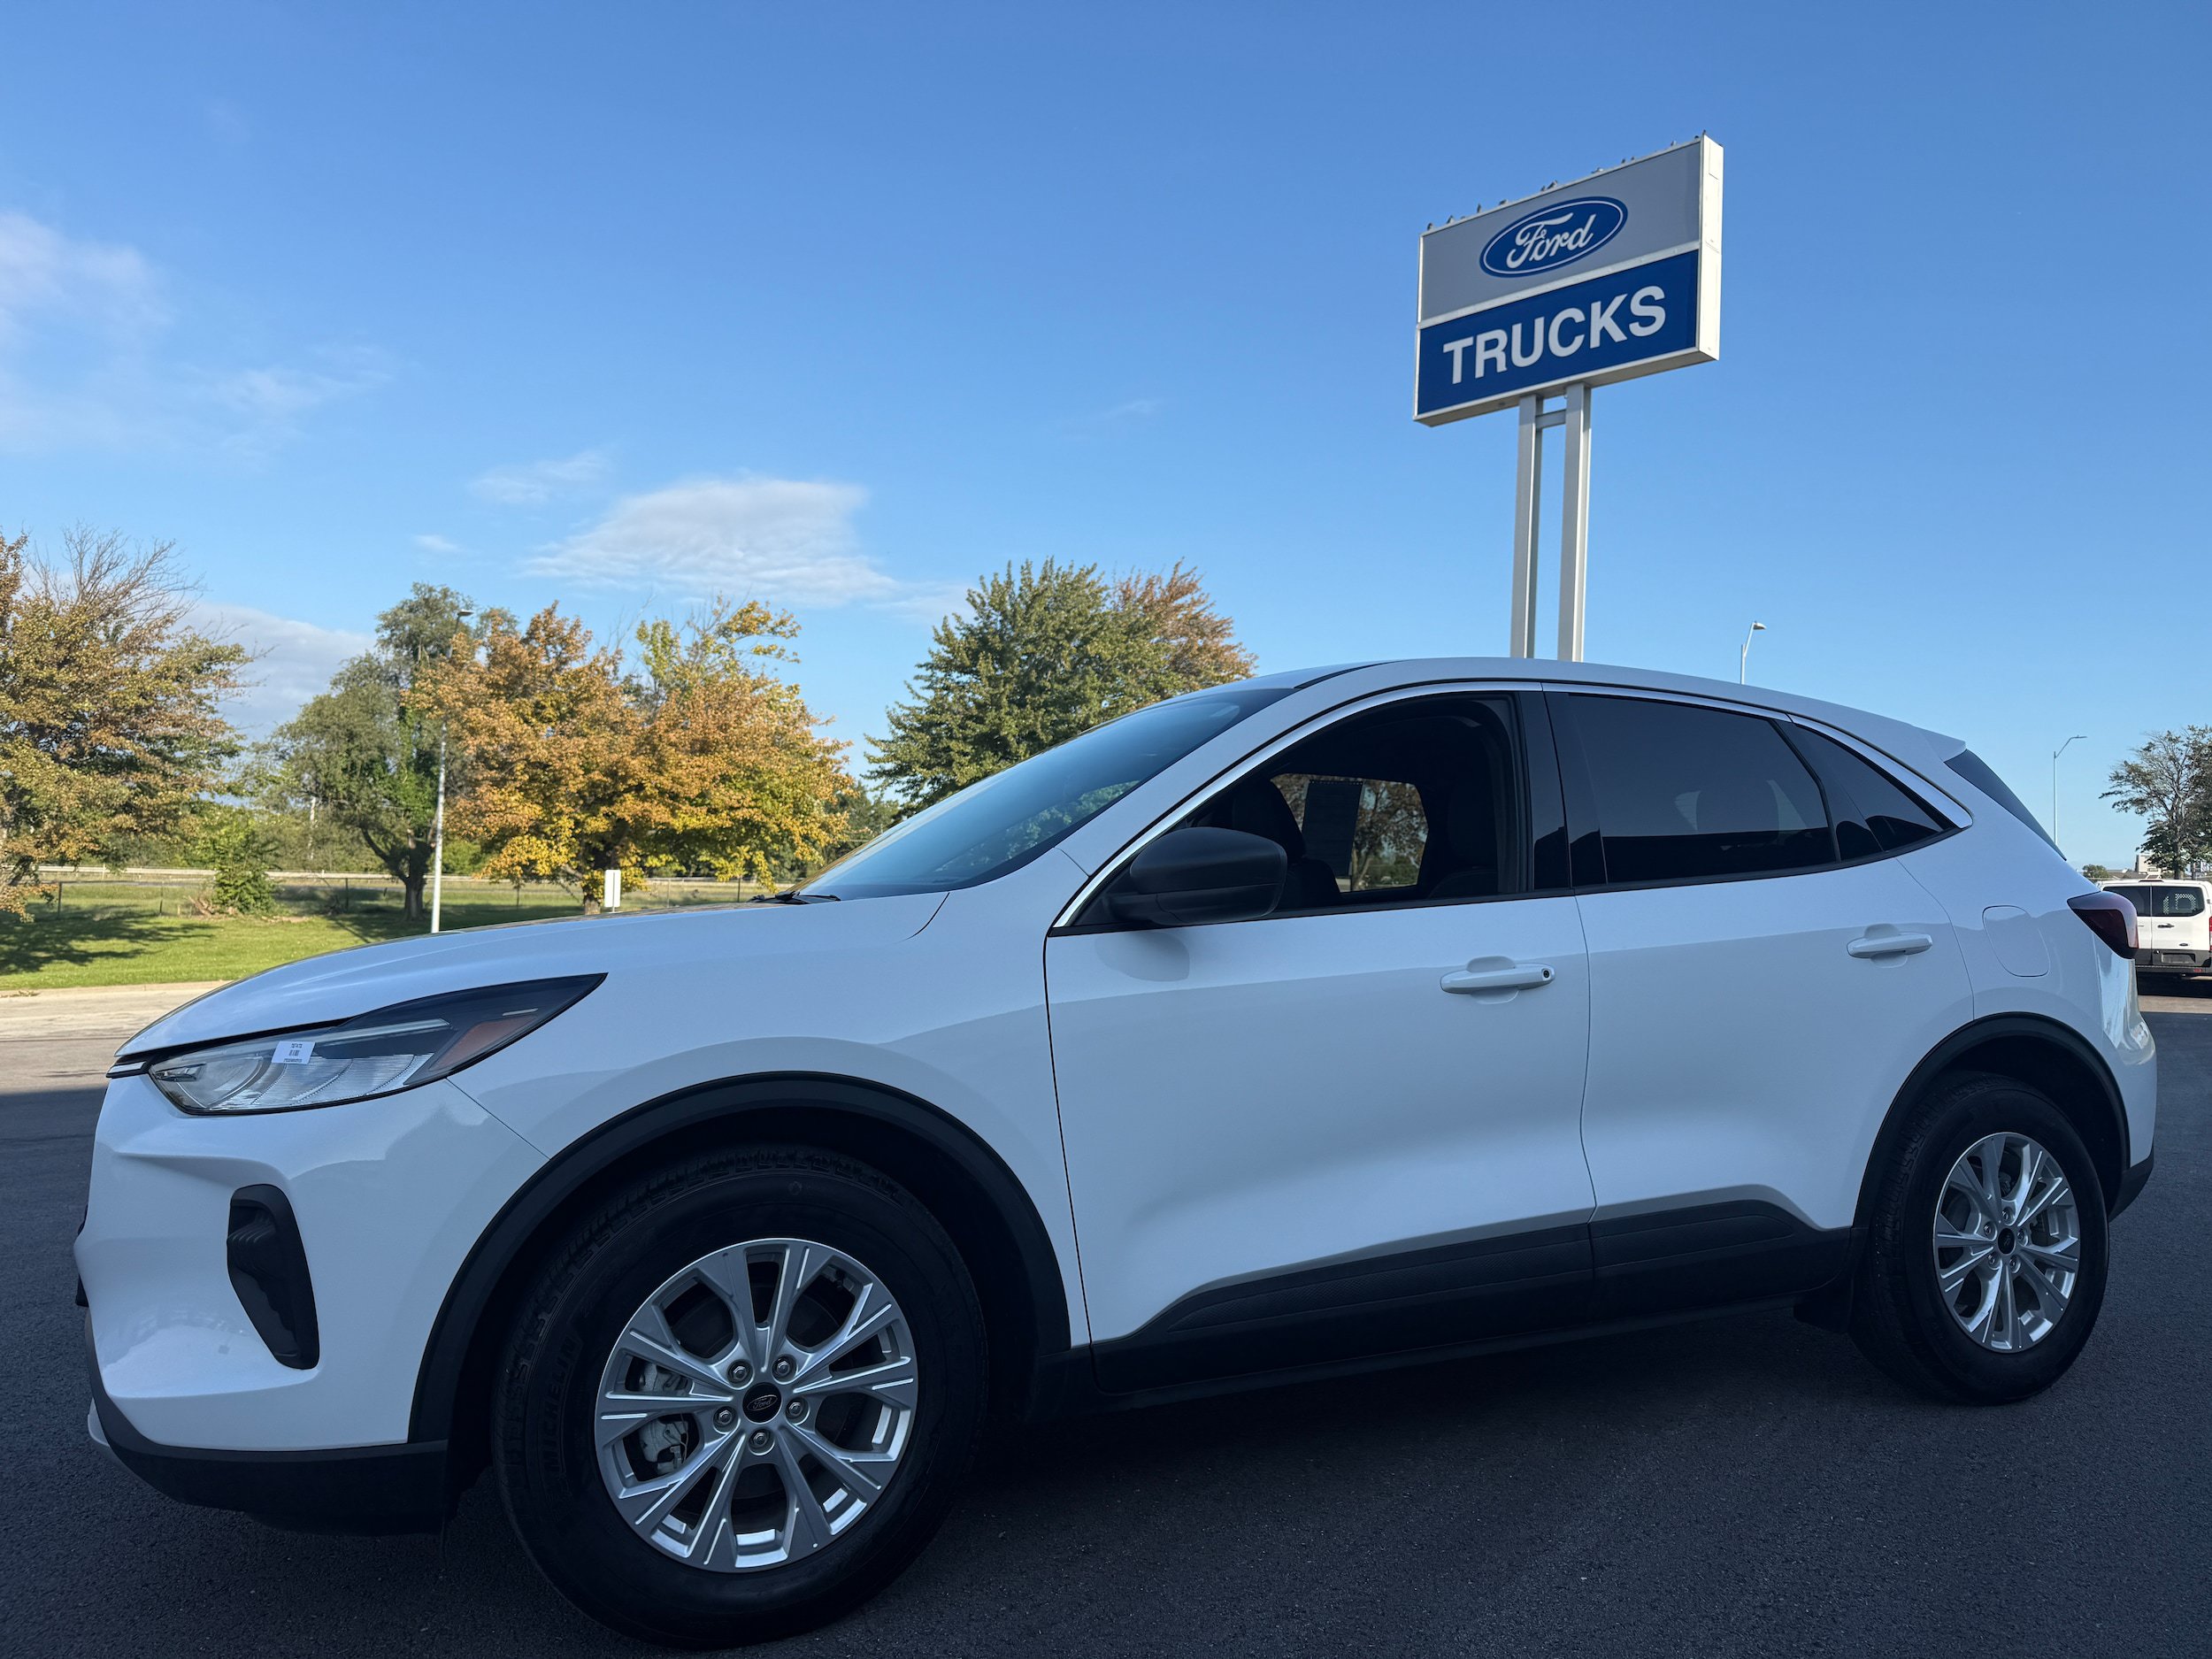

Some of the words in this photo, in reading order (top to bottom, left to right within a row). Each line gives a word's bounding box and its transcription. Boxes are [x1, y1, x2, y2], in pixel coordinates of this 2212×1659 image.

[1506, 212, 1596, 268] Ford
[1443, 286, 1666, 384] TRUCKS
[543, 1332, 577, 1470] MICHELIN
[752, 1397, 772, 1409] Ford
